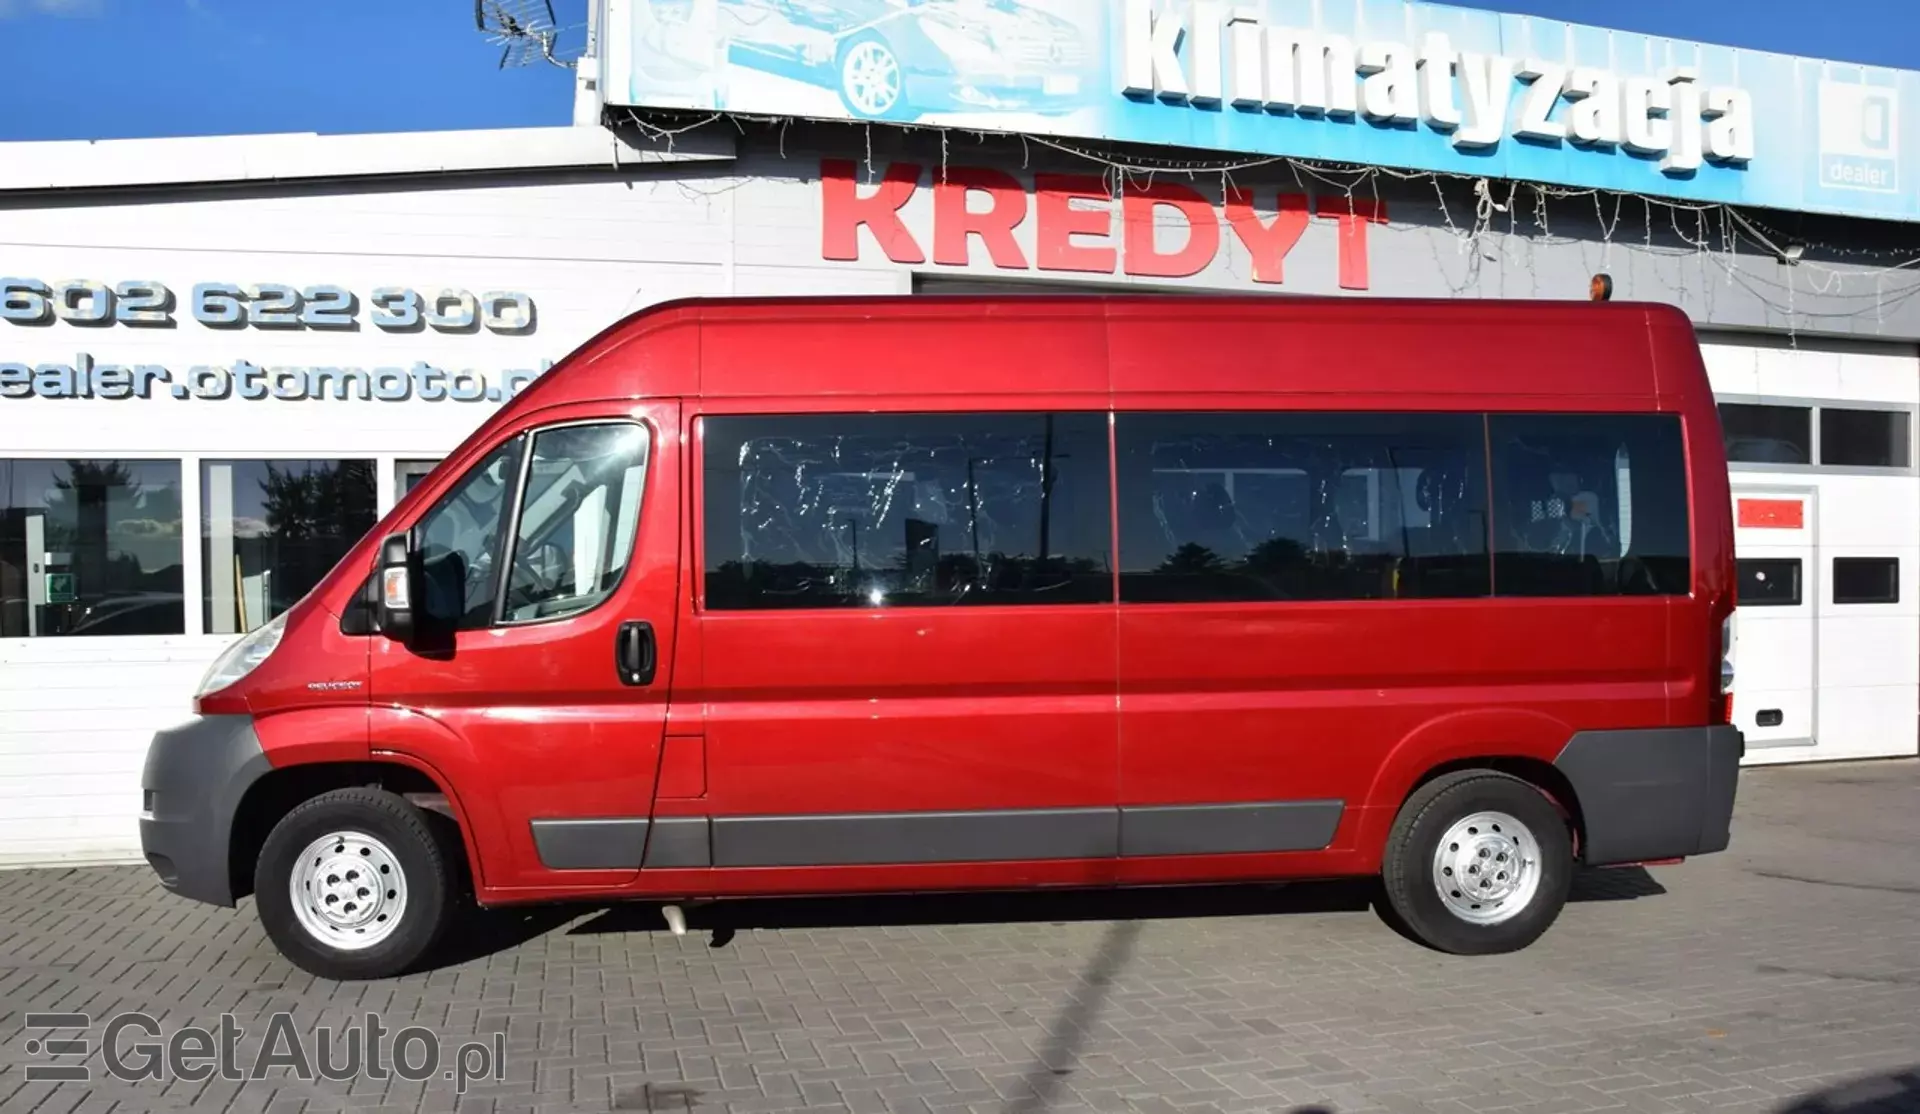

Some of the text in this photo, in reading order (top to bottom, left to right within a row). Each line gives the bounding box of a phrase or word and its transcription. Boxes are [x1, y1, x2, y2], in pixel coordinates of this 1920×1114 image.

[1122, 0, 1753, 172] klimatyzacja
[1830, 158, 1888, 185] dealer
[820, 159, 1387, 290] KREDYT
[0, 277, 537, 335] 602 622 300
[0, 352, 553, 404] ealer.otomoto.p
